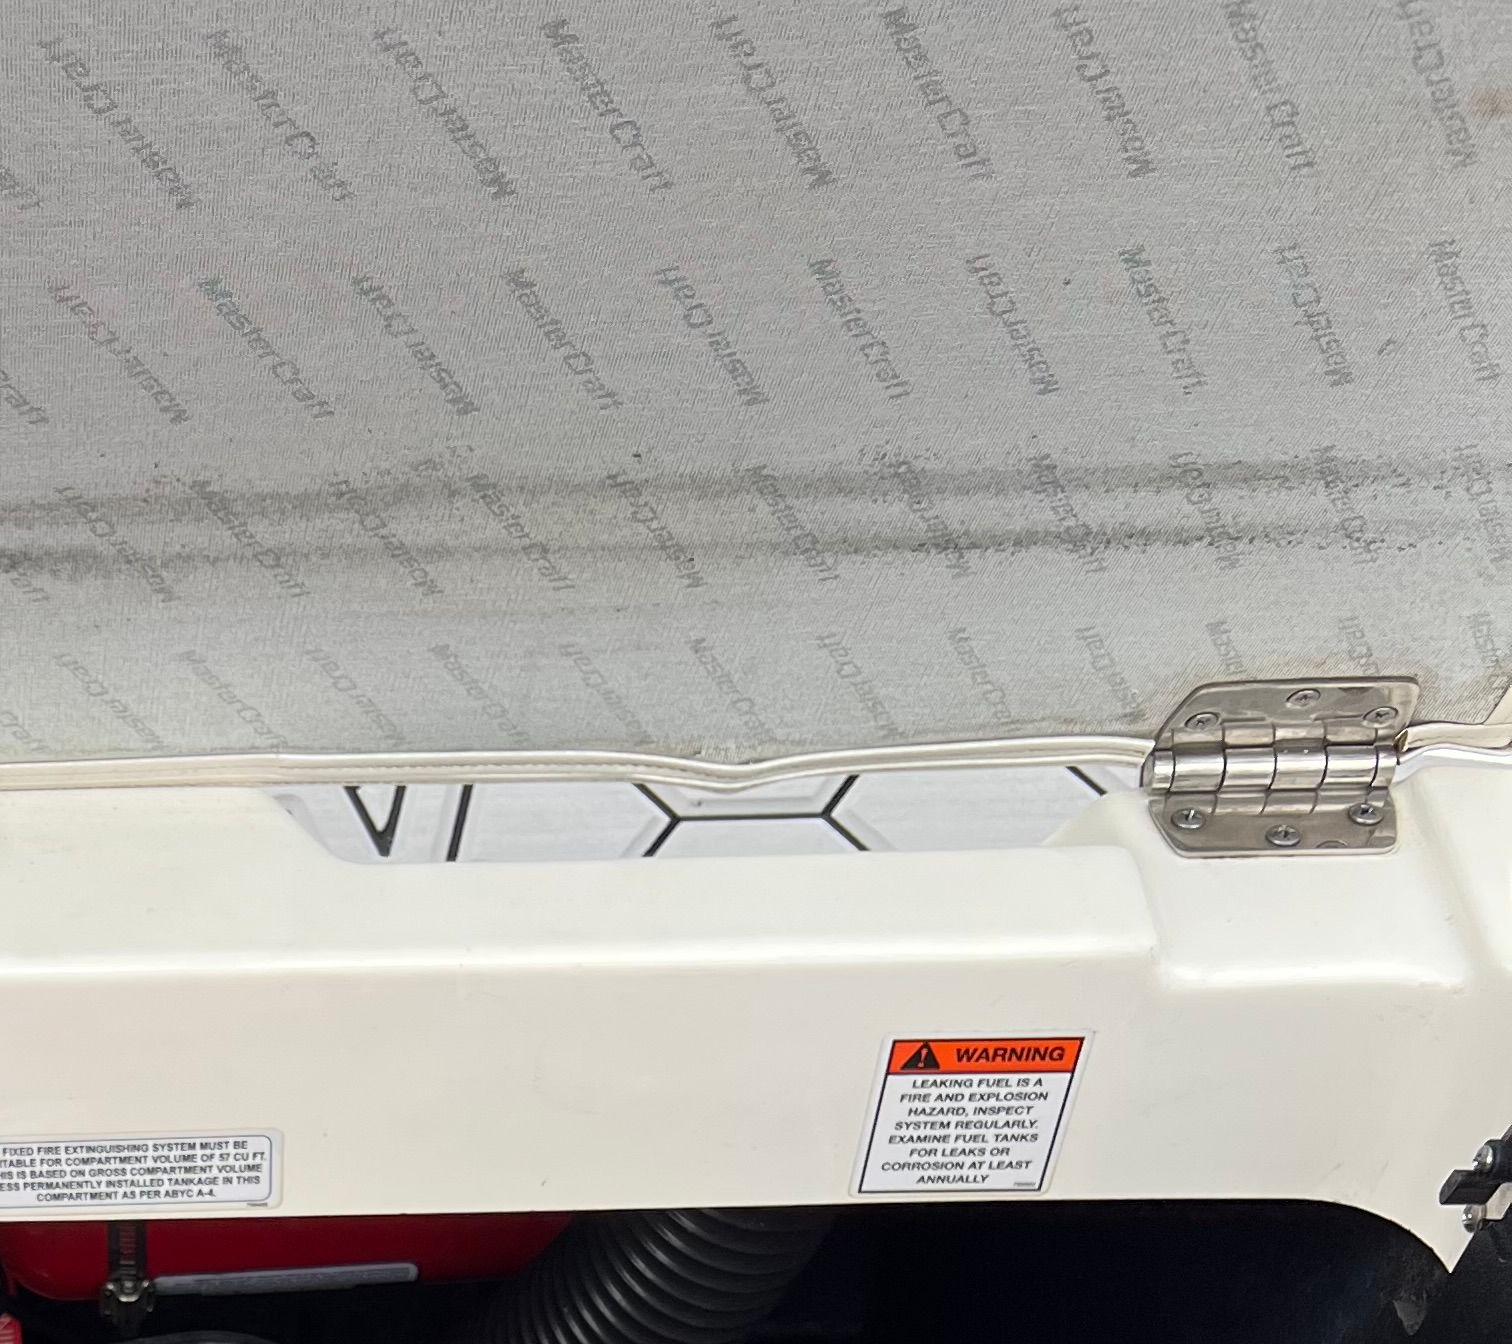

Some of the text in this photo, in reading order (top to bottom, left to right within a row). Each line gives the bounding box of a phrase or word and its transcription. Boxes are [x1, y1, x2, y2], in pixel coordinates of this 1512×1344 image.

[38, 34, 194, 211] MasterCraft
[204, 28, 355, 203] MasterCraft
[372, 25, 516, 201] MasterCraft
[539, 17, 675, 195] MasterCraft
[712, 13, 839, 191] MasterCraft
[881, 6, 994, 181] MasterCraft
[1051, 5, 1158, 178] MasterCraft
[1224, 0, 1317, 175] MasterCraft
[47, 282, 191, 425] MasterCraft
[197, 276, 337, 419] MasterCraft
[350, 274, 480, 417] MasterCraft
[502, 267, 624, 412] MasterCraft
[650, 264, 769, 407] MasterCraft
[807, 257, 912, 400] MasterCraft
[965, 252, 1061, 397] MasterCraft
[1117, 245, 1207, 395] MasterCraft
[1273, 242, 1356, 389] MasterCraft
[1428, 237, 1503, 384] MasterCraft
[895, 1120, 1038, 1131] SYSTEM REGULARLY.
[900, 1092, 1049, 1103] FIRE AND EXPLOSION
[908, 1106, 1034, 1117] HAZARD, INSPECT
[912, 1078, 1043, 1089] LEAKING FUEL IS A
[955, 1047, 1065, 1063] WARNING
[2, 1140, 248, 1157] FIXED FIRE EXTINGUISHING SYSTEM MUST BE
[16, 1170, 26, 1180] IS
[30, 1169, 67, 1179] BASED
[71, 1168, 85, 1178] ON
[89, 1167, 127, 1177] GROSS
[131, 1165, 214, 1177] COMPARTMENT
[217, 1164, 262, 1174] VOLUME
[23, 1179, 102, 1191] PERMANENTLY
[105, 1177, 164, 1189] INSTALLED
[168, 1176, 219, 1187] TANKAGE
[222, 1176, 232, 1185] IN
[236, 1175, 261, 1185] THIS
[37, 1191, 118, 1202] COMPARTMENT
[121, 1190, 135, 1200] AS
[139, 1190, 161, 1200] PER
[164, 1189, 194, 1199] ABYC
[40, 1157, 62, 1167] FOR
[65, 1155, 147, 1166] COMPARTMENT
[152, 1153, 198, 1164] VOLUME
[201, 1153, 215, 1162] OF
[234, 1152, 249, 1162] CU
[881, 1160, 1032, 1171] CORROSION AT LEAST
[888, 1133, 1039, 1144] EXAMINE FUEL TANKS
[910, 1147, 1010, 1157] FOR LEAKS OR
[916, 1174, 990, 1184] ANNUALLY
